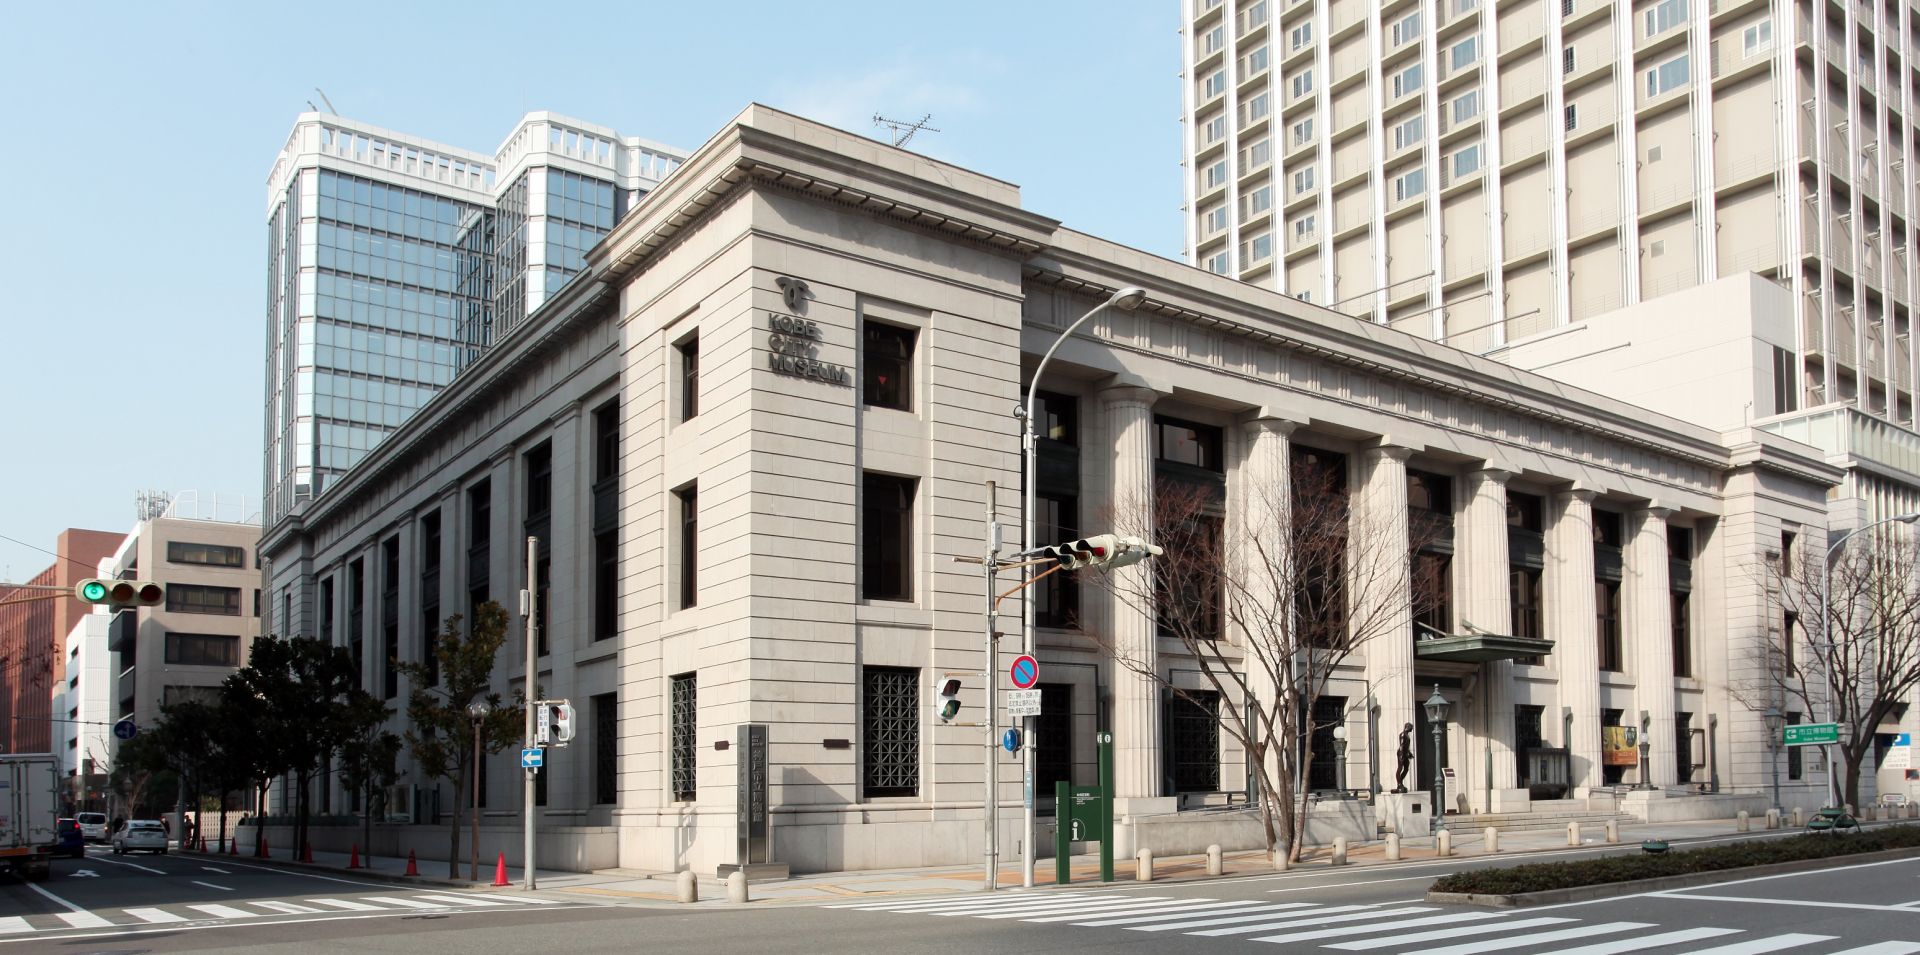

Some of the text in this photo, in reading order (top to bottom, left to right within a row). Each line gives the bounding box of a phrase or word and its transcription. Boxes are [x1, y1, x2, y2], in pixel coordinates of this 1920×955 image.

[768, 312, 817, 337] KOBE
[767, 333, 814, 356] CITY
[768, 352, 846, 383] MUSEUM
